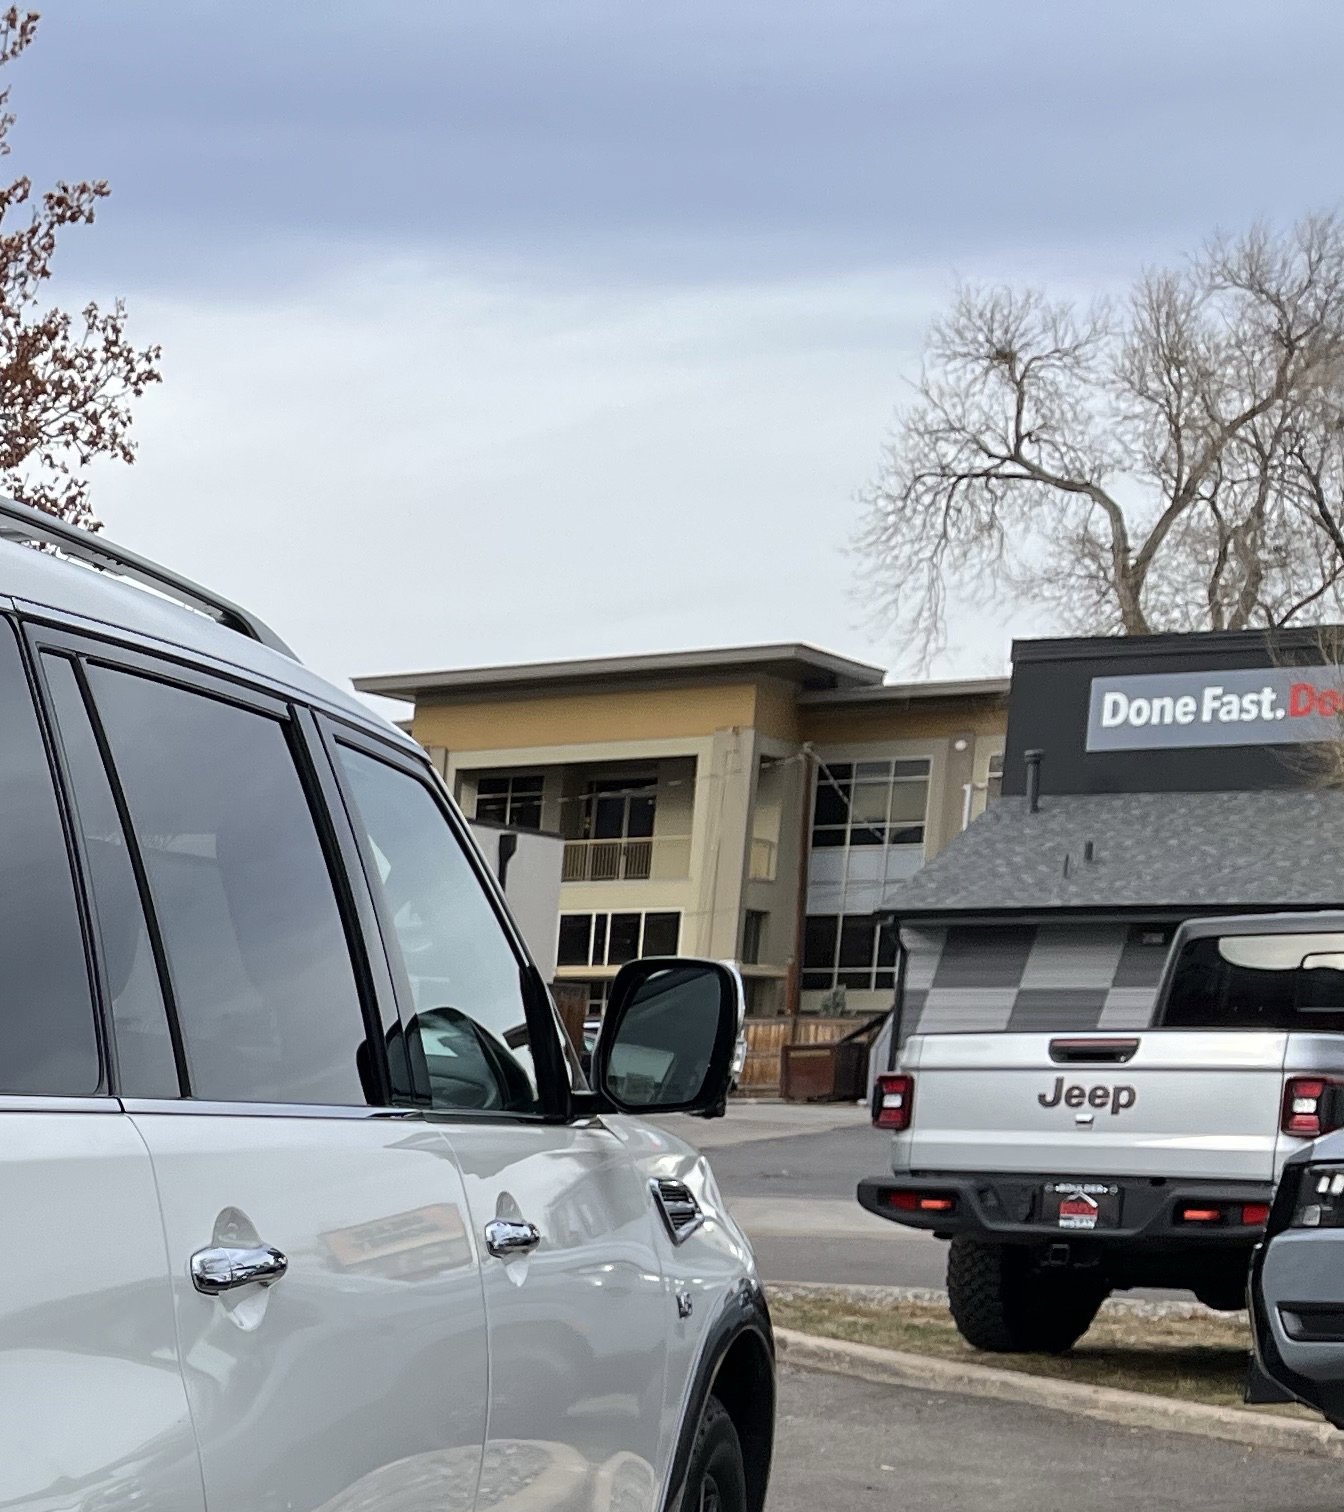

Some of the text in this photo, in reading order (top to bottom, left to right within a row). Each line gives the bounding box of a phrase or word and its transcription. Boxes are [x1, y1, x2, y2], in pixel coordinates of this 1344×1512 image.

[1101, 690, 1197, 728] Done
[1201, 686, 1286, 723] Fast.
[1038, 1076, 1137, 1115] Jeep
